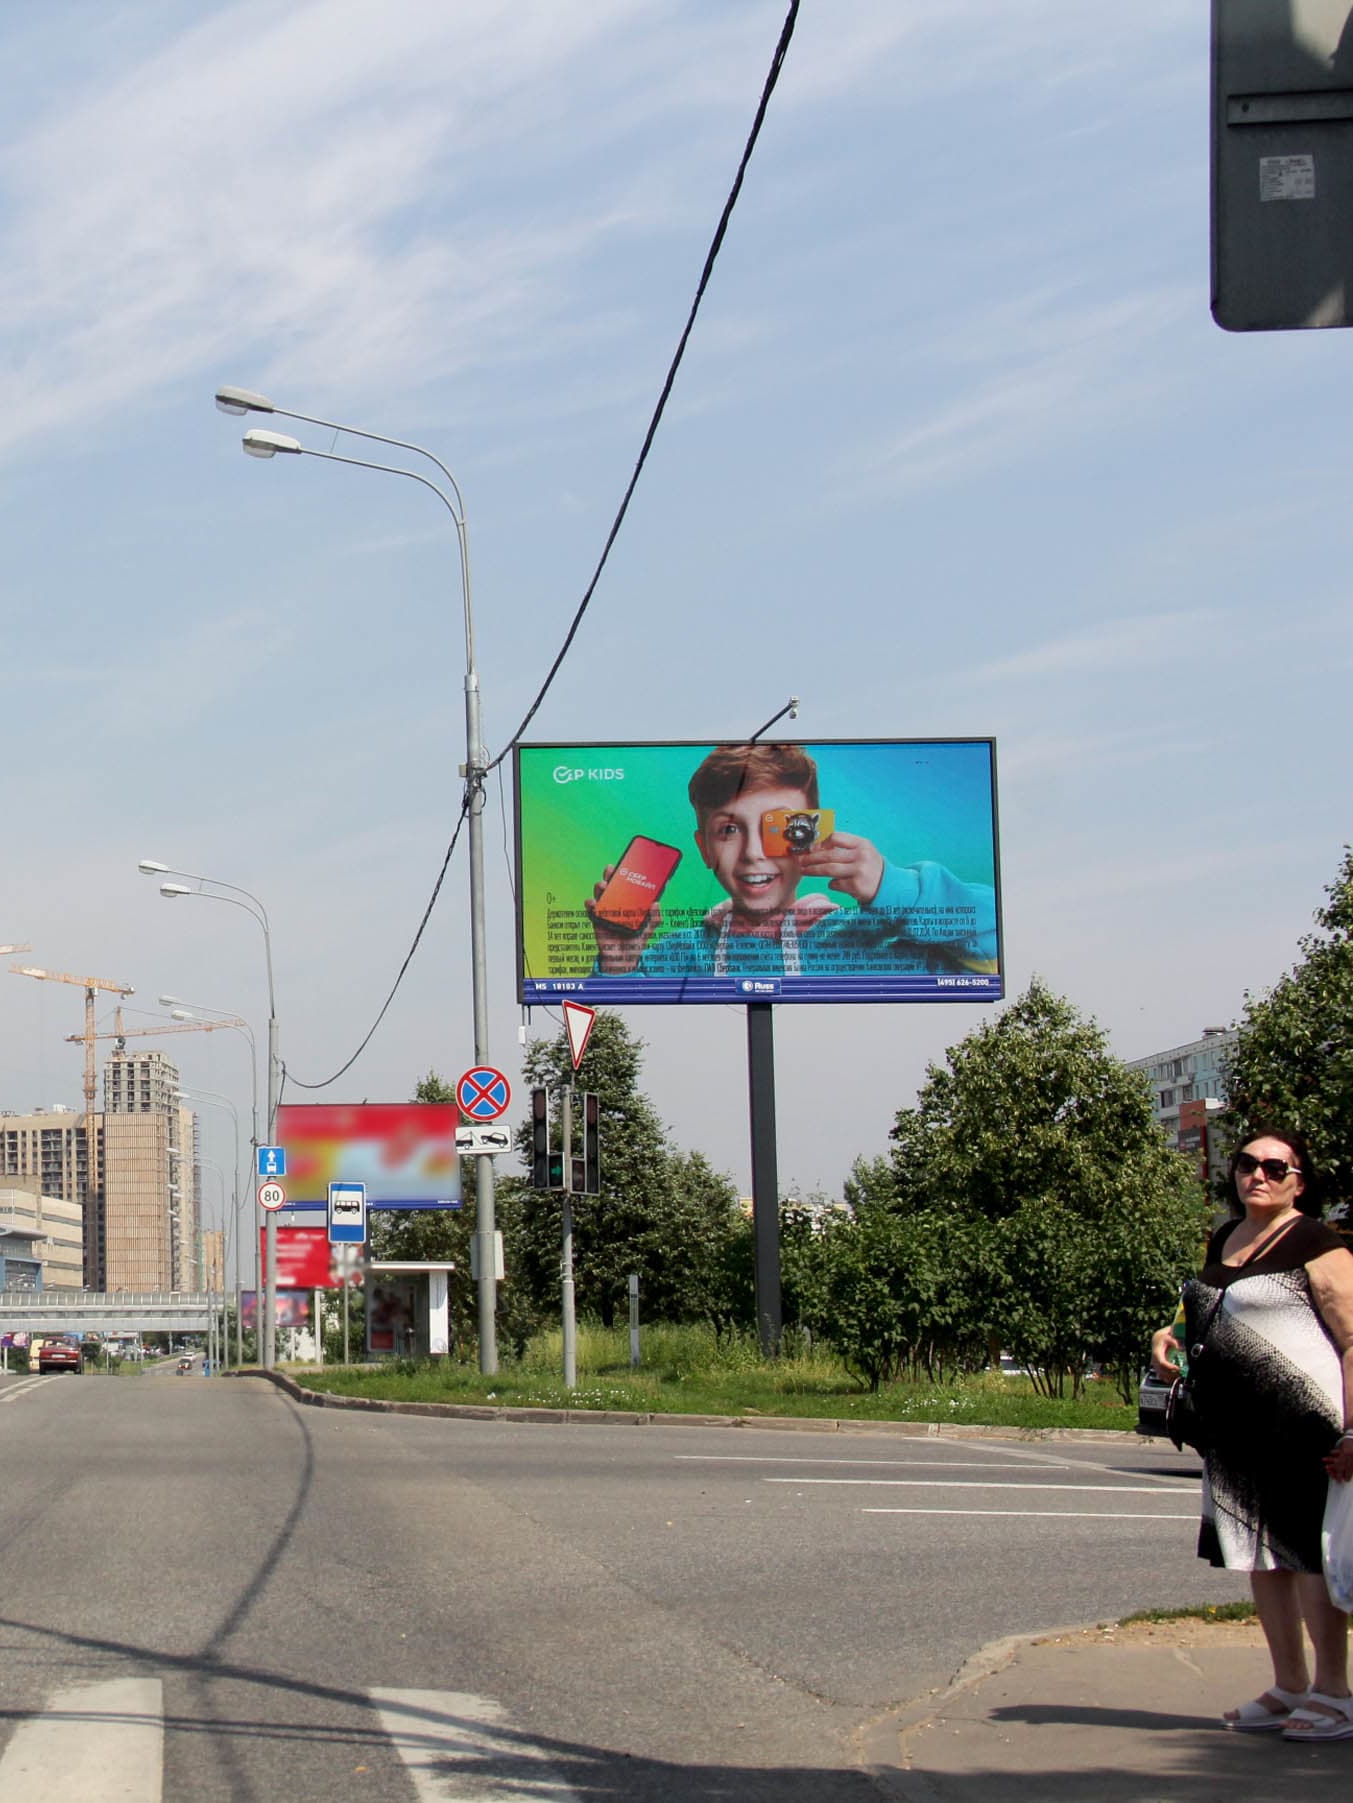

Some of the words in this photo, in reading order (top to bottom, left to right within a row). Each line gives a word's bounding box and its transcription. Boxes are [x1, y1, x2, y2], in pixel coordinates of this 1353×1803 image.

[588, 768, 624, 781] KIDS
[754, 982, 775, 990] Russ
[956, 977, 990, 987] 626-5200
[264, 1190, 280, 1202] 80
